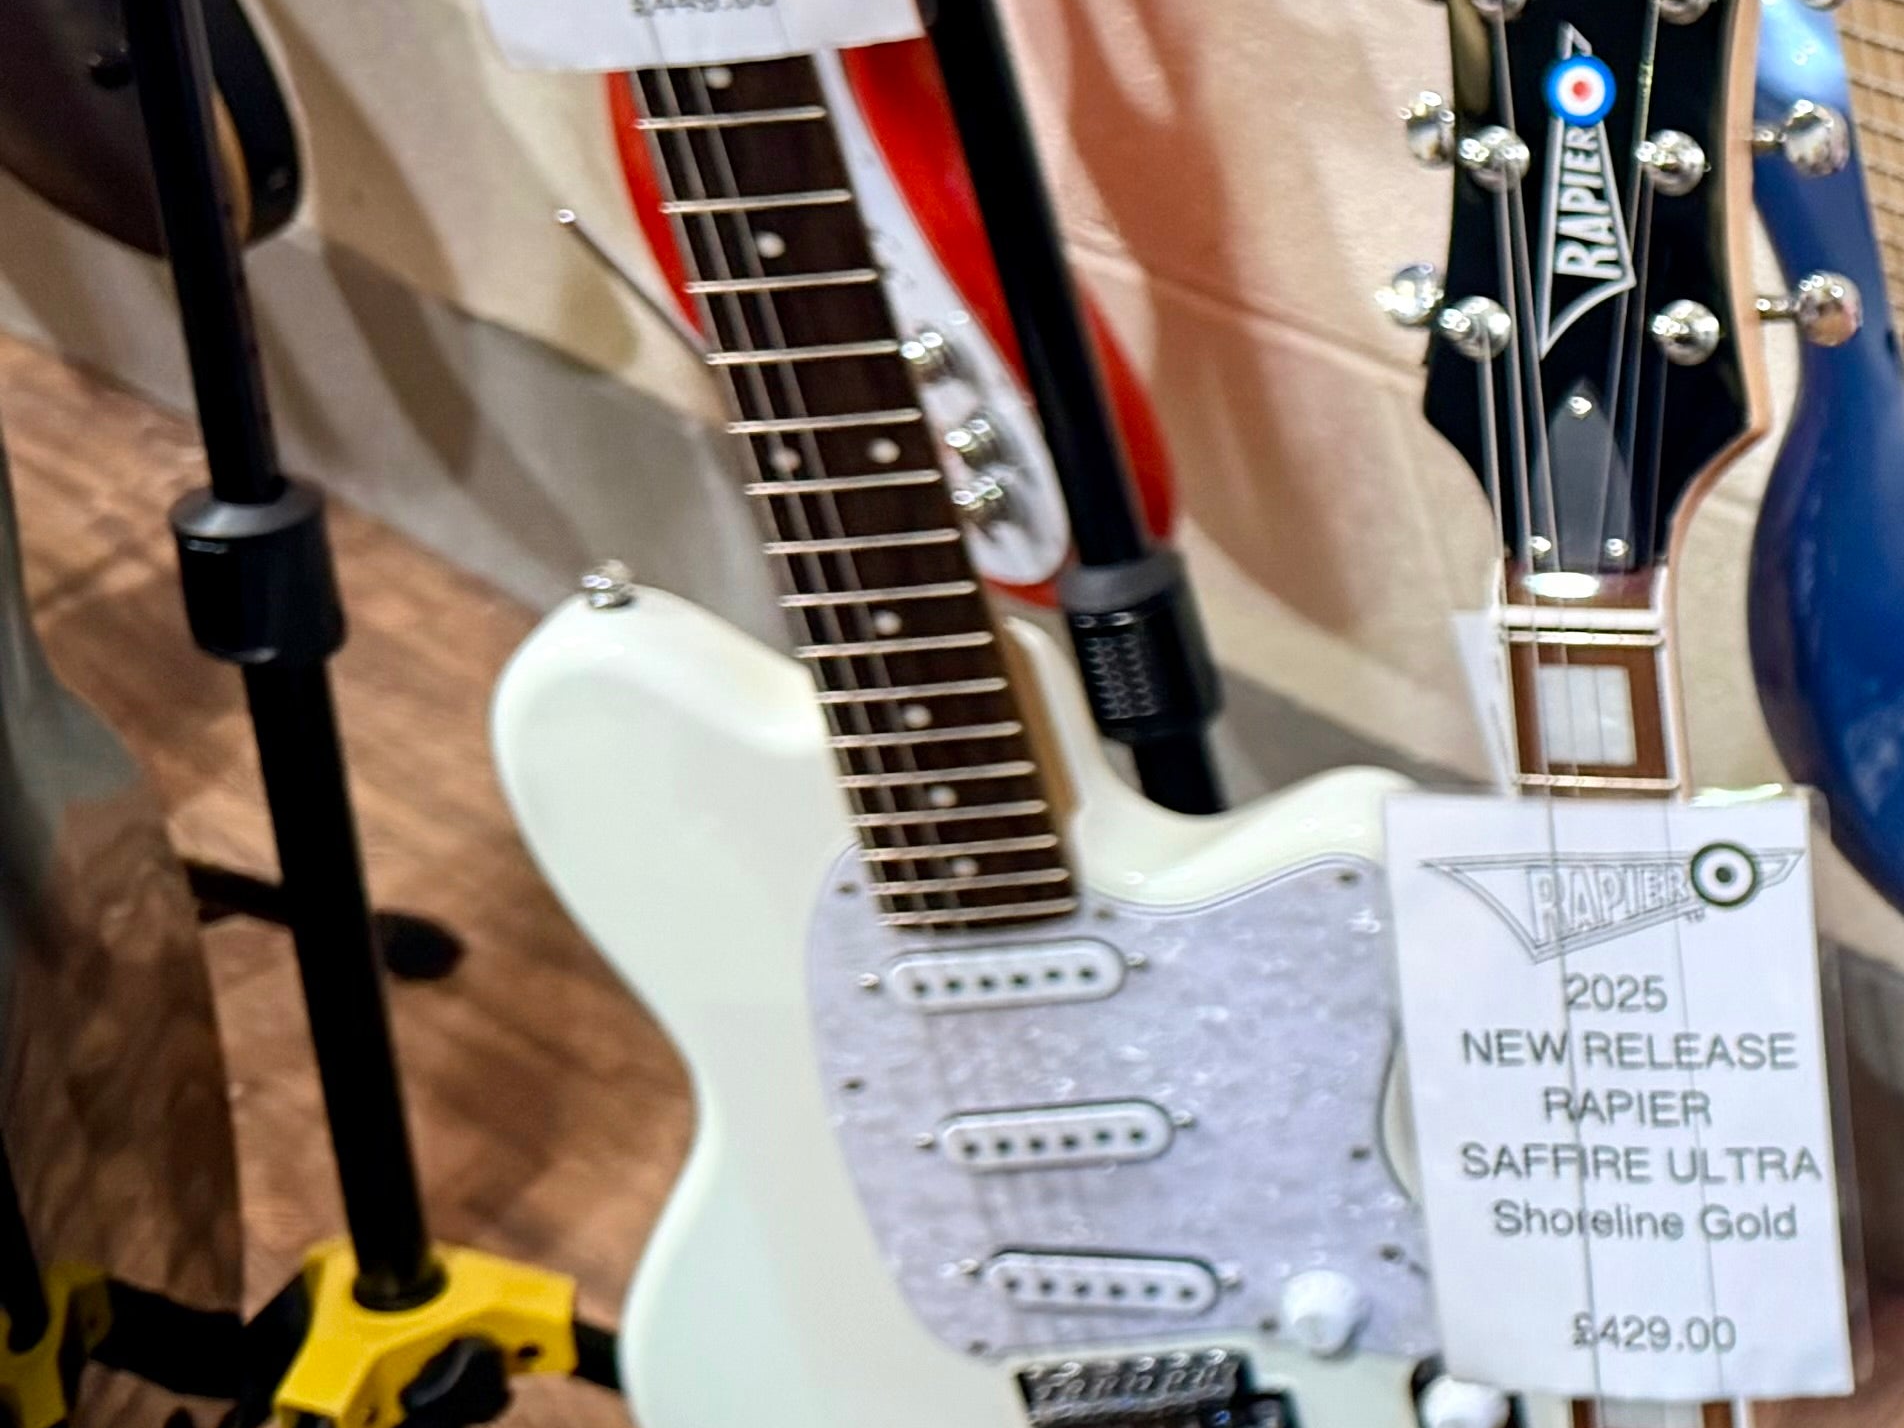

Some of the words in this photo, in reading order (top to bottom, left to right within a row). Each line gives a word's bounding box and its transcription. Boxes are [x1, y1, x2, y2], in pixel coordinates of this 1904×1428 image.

[1556, 127, 1623, 279] RAPIER
[1525, 863, 1692, 940] RAPIER
[1565, 973, 1667, 1013] 2025
[1462, 1028, 1569, 1067] NEW
[1584, 1029, 1799, 1071] RELEASE
[1542, 1086, 1712, 1129] RAPIER
[1460, 1141, 1652, 1185] SAFFIRE
[1666, 1145, 1823, 1185] ULTRA
[1493, 1197, 1684, 1241] Shoreline
[1699, 1203, 1798, 1241] Gold
[1573, 1312, 1737, 1353] £429.00
